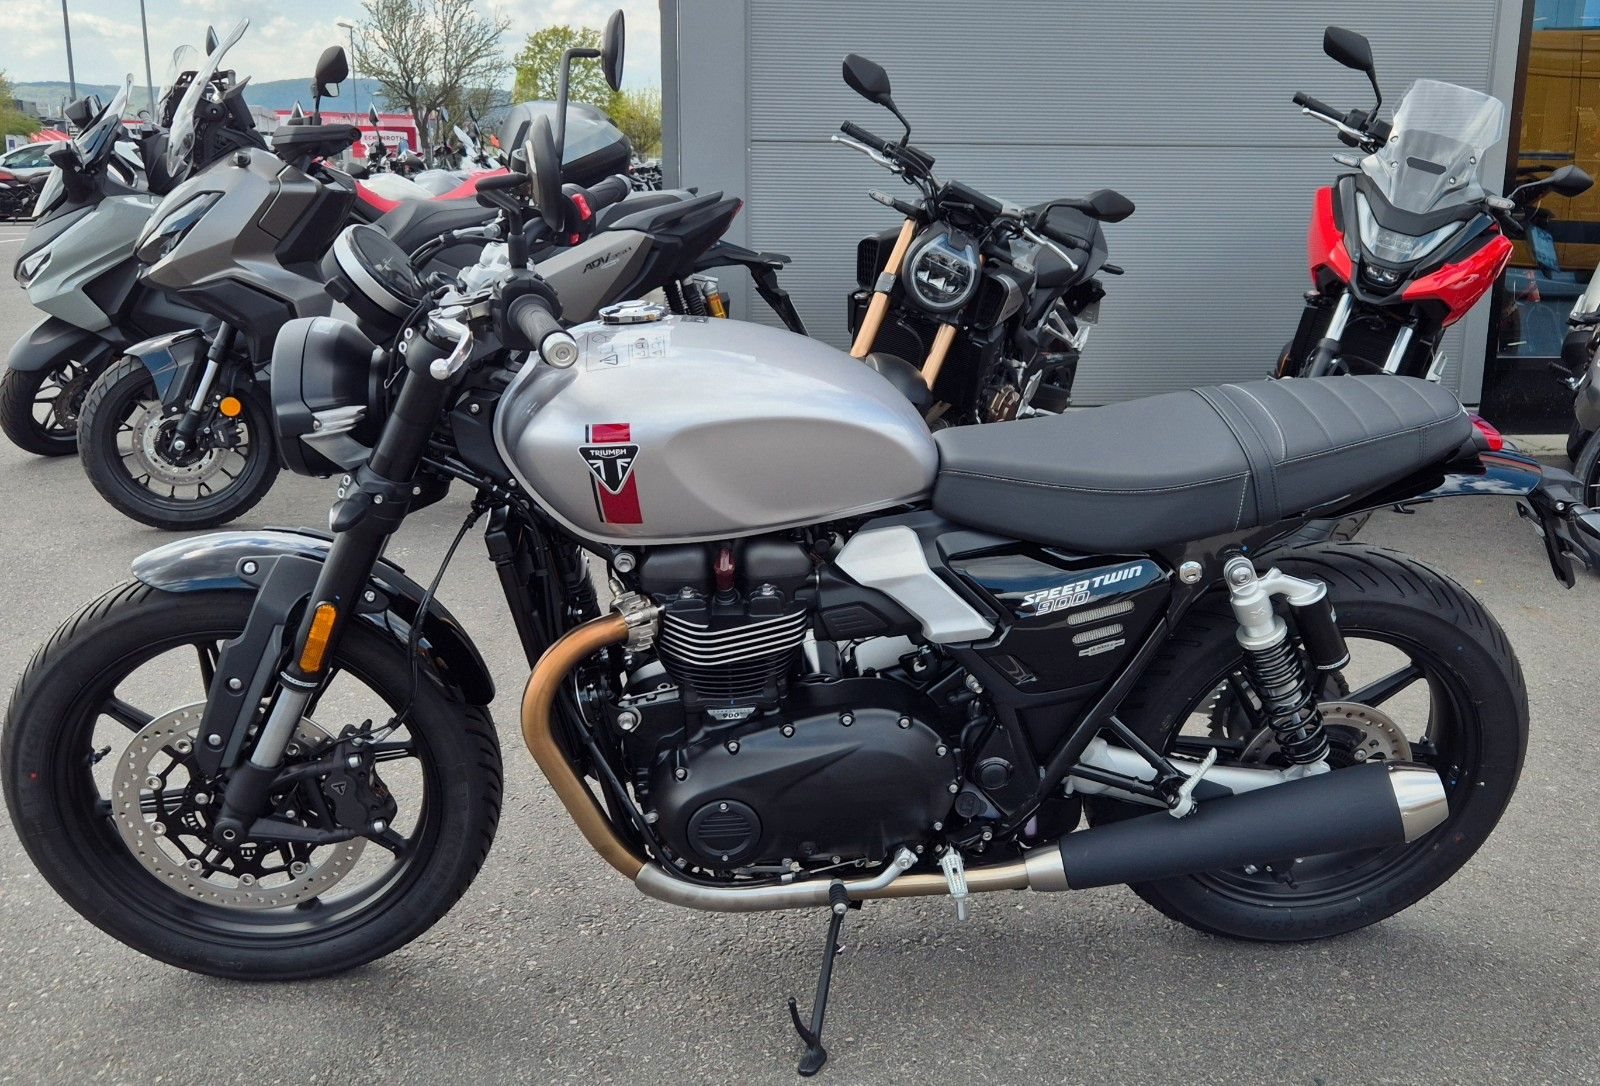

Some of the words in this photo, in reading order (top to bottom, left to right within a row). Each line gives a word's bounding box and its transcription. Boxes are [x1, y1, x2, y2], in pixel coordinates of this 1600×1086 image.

[583, 252, 611, 273] ADV
[589, 448, 627, 458] TRIUMPH
[1021, 580, 1090, 606] SPEED
[1091, 566, 1142, 587] TWIN
[1035, 591, 1091, 616] 900
